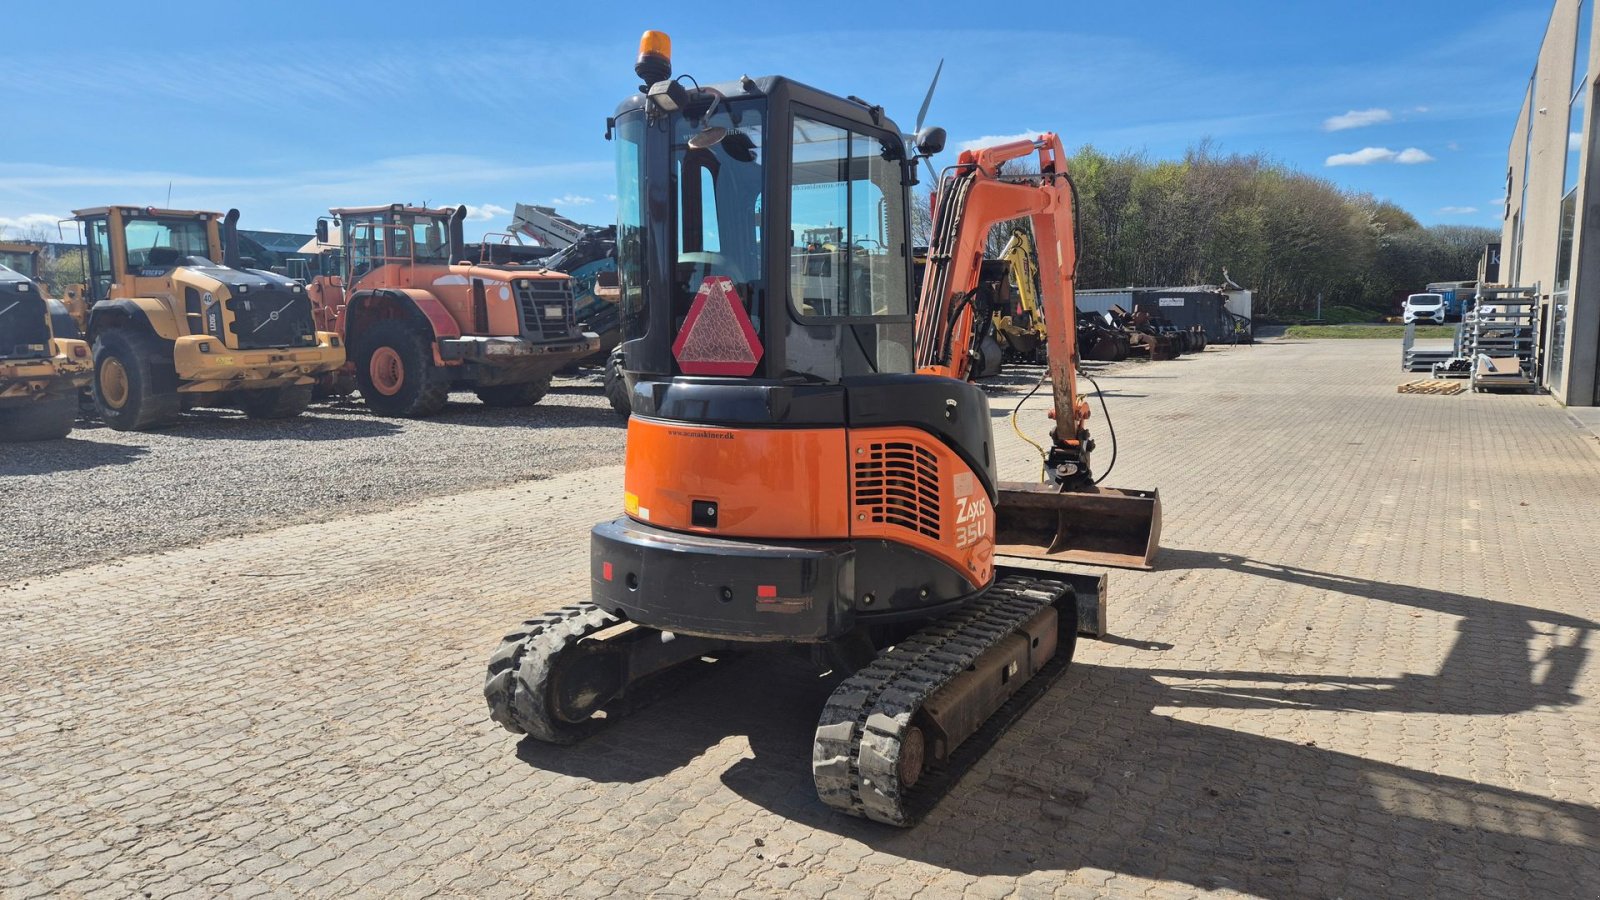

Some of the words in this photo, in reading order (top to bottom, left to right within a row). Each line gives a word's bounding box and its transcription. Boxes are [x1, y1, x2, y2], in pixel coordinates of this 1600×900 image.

[209, 313, 217, 331] L120G
[956, 497, 986, 525] ZAXIS
[956, 518, 986, 549] 35U
